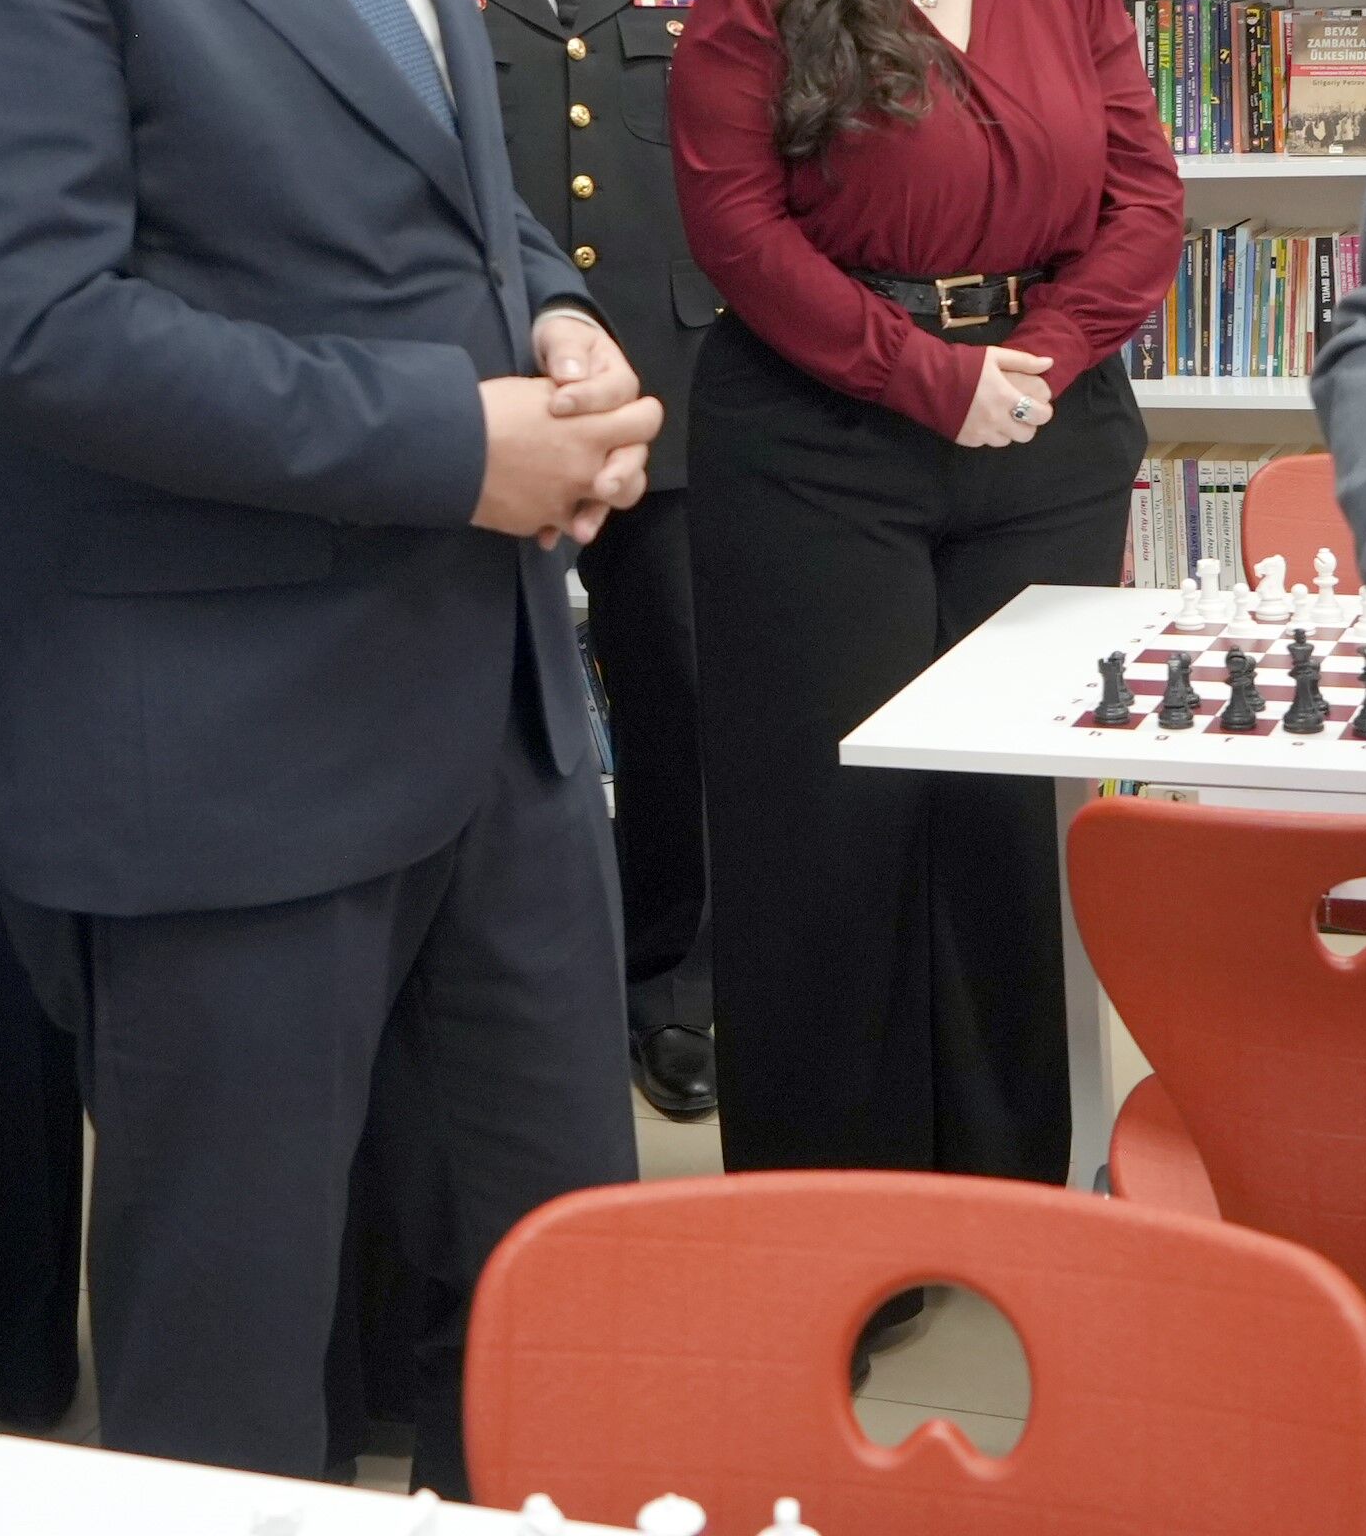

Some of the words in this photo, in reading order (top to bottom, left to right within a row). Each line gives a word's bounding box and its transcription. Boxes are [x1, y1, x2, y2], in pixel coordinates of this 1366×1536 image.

[1324, 26, 1359, 37] BEYAZ
[1342, 78, 1365, 86] Petrov
[1321, 277, 1331, 303] ORWELL
